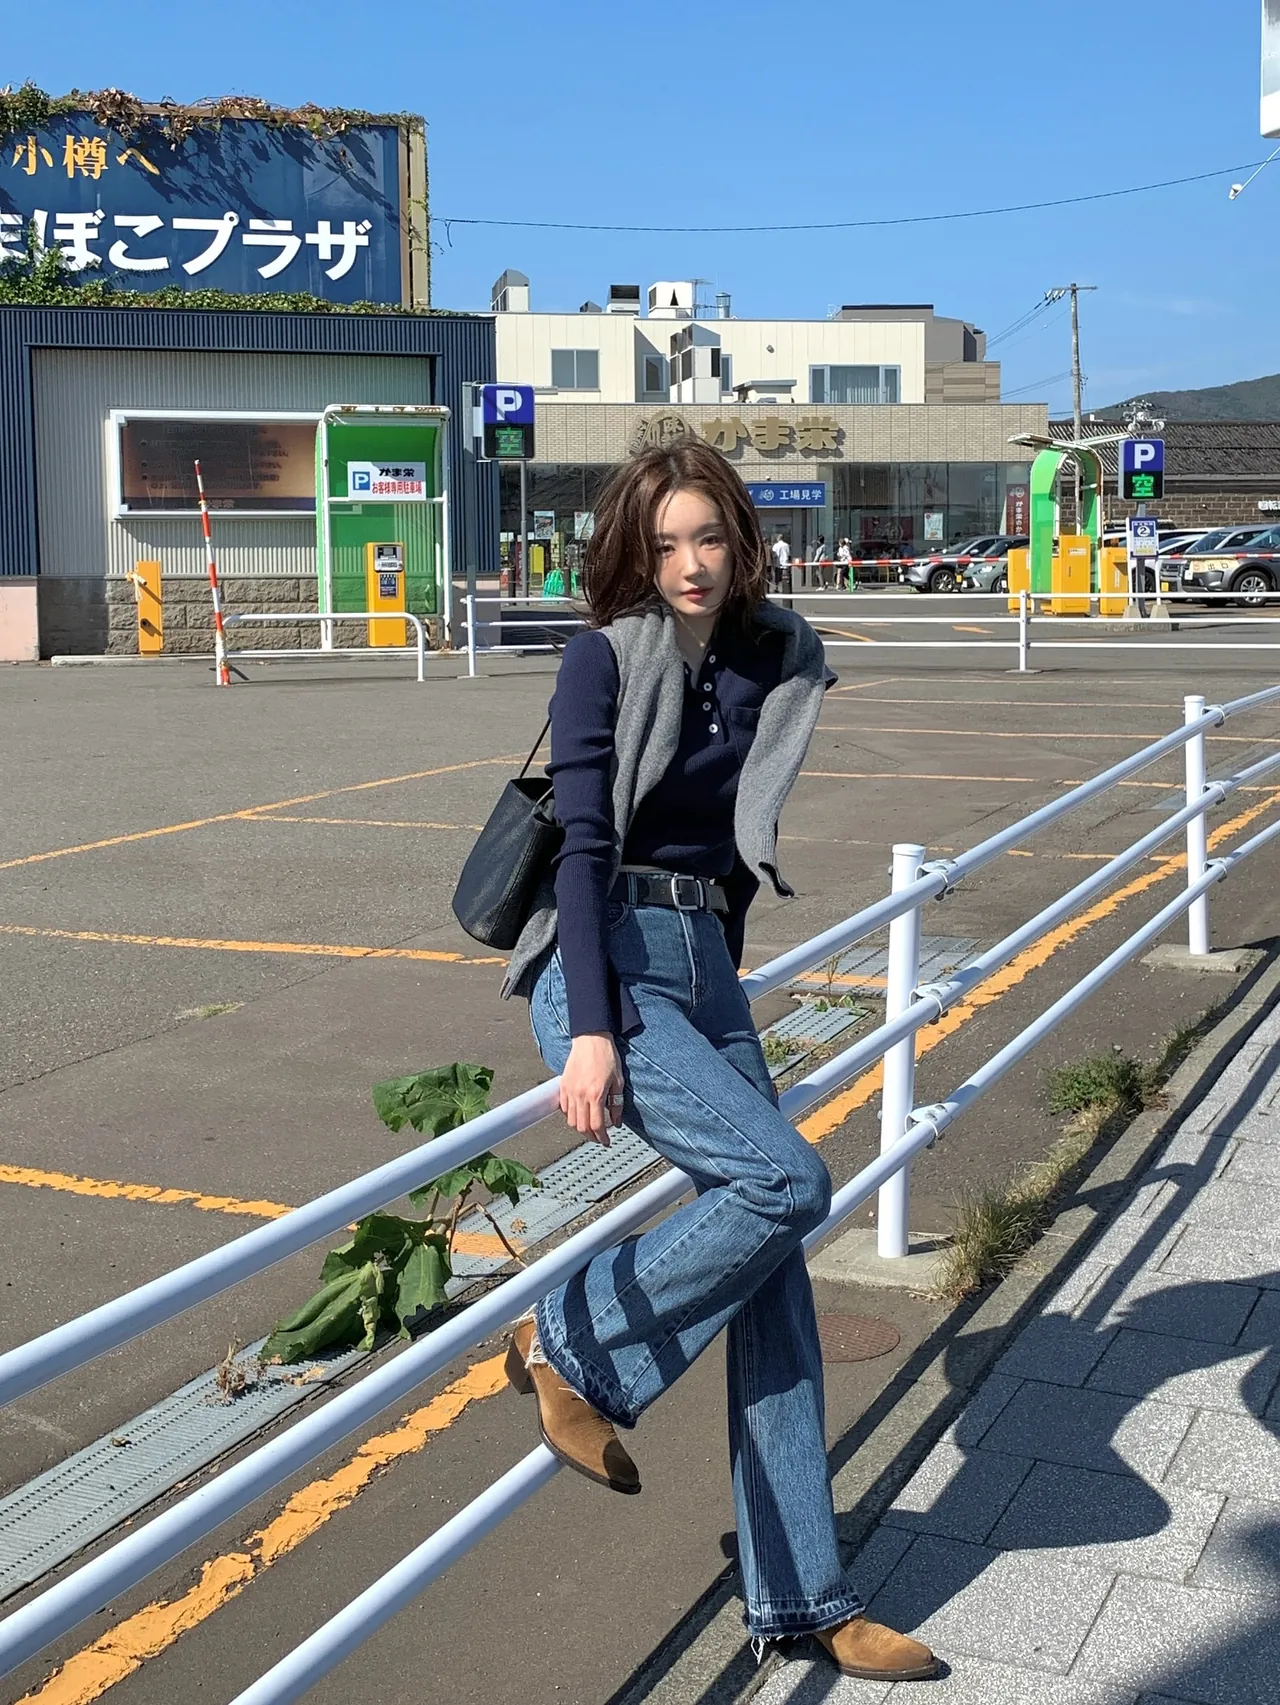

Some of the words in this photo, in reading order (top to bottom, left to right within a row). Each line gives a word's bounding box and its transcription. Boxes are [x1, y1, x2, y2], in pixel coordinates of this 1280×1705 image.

[11, 134, 161, 181] 小樽へ
[496, 389, 523, 421] P
[495, 426, 525, 456] 空
[700, 416, 840, 452] かま栄
[1134, 443, 1156, 469] P
[354, 473, 369, 489] P
[379, 468, 415, 477] かま栄
[1132, 473, 1155, 497] 空
[372, 481, 422, 494] お客様専用駐車場
[779, 490, 822, 500] 工場見学
[1015, 500, 1024, 536] かま栄のか
[1139, 526, 1148, 535] 2
